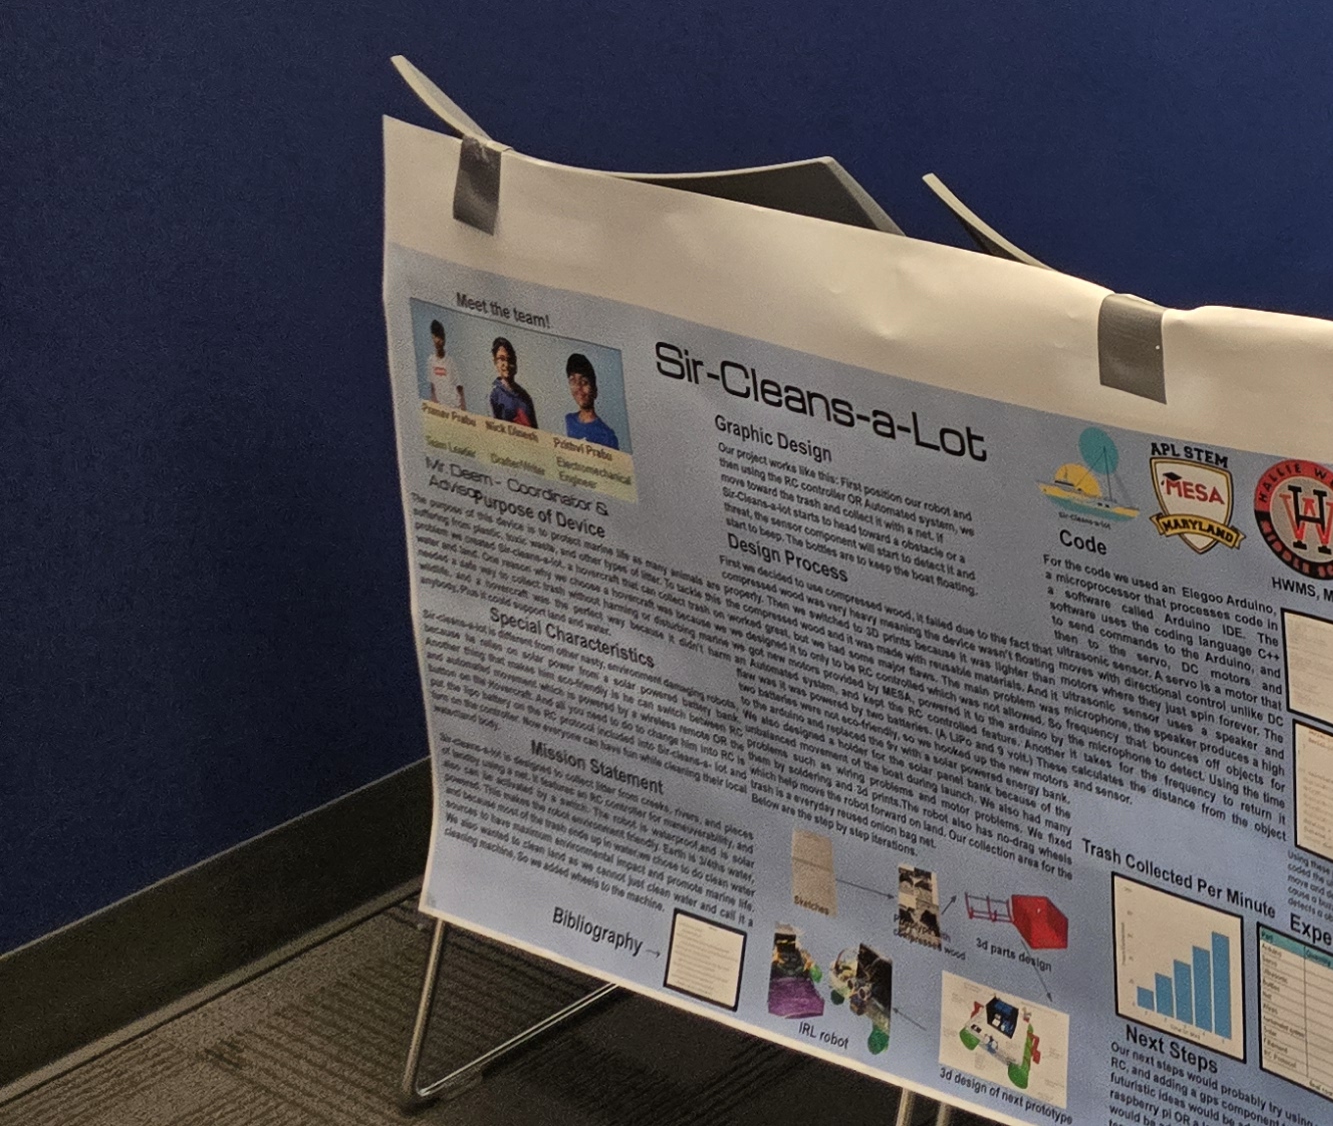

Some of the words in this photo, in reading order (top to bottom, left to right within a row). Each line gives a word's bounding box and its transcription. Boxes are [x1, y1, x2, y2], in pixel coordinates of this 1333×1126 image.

[456, 293, 487, 312] Meet
[490, 300, 509, 320] the
[513, 310, 551, 329] team!
[655, 341, 986, 462] Sir-Cleans-a-Lot
[715, 415, 773, 447] Graphic
[777, 431, 832, 463] Design
[1151, 442, 1179, 458] APL
[1184, 447, 1228, 468] STEM
[1259, 463, 1303, 503] HALLIE
[538, 509, 552, 523] of
[556, 512, 606, 539] Device
[1059, 528, 1107, 555] Code
[1164, 517, 1234, 543] MARYLAND
[728, 532, 781, 564] Design
[785, 550, 848, 582] Process
[1043, 554, 1061, 566] For
[1064, 559, 1081, 572] the
[1085, 565, 1111, 579] code
[1113, 573, 1129, 583] we
[1132, 577, 1158, 591] used
[1162, 585, 1176, 595] an
[1182, 587, 1223, 604] Elegoo
[1046, 571, 1052, 579] a
[1056, 573, 1141, 601] microprocessor
[1145, 594, 1166, 608] that
[1170, 602, 1230, 621] processes
[1235, 613, 1263, 628] code
[1267, 620, 1278, 630] in
[1271, 577, 1320, 601] HWMS,
[490, 606, 542, 639] Special
[545, 619, 655, 669] Characteristics
[531, 739, 586, 772] Mission
[590, 757, 664, 795] Statement
[1082, 838, 1121, 865] Trash
[1125, 853, 1192, 889] Collected
[1197, 878, 1222, 899] Per
[1227, 887, 1276, 919] Minute
[552, 905, 644, 957] Bibliography
[976, 937, 988, 949] 3d
[990, 943, 1016, 961] parts
[1019, 953, 1052, 972] design
[799, 1022, 816, 1039] IRL
[819, 1029, 850, 1049] robot
[1126, 1024, 1165, 1053] Next
[1169, 1041, 1218, 1074] Steps
[940, 1068, 952, 1080] 3d
[954, 1072, 987, 1094] design
[989, 1084, 1000, 1097] of
[1002, 1089, 1023, 1108] next
[1025, 1098, 1073, 1125] prototype
[1111, 1041, 1129, 1055] Our
[1132, 1050, 1154, 1065] next
[1157, 1059, 1184, 1079] steps
[1188, 1070, 1218, 1090] would
[1221, 1084, 1266, 1111] probably
[1269, 1100, 1283, 1117] try
